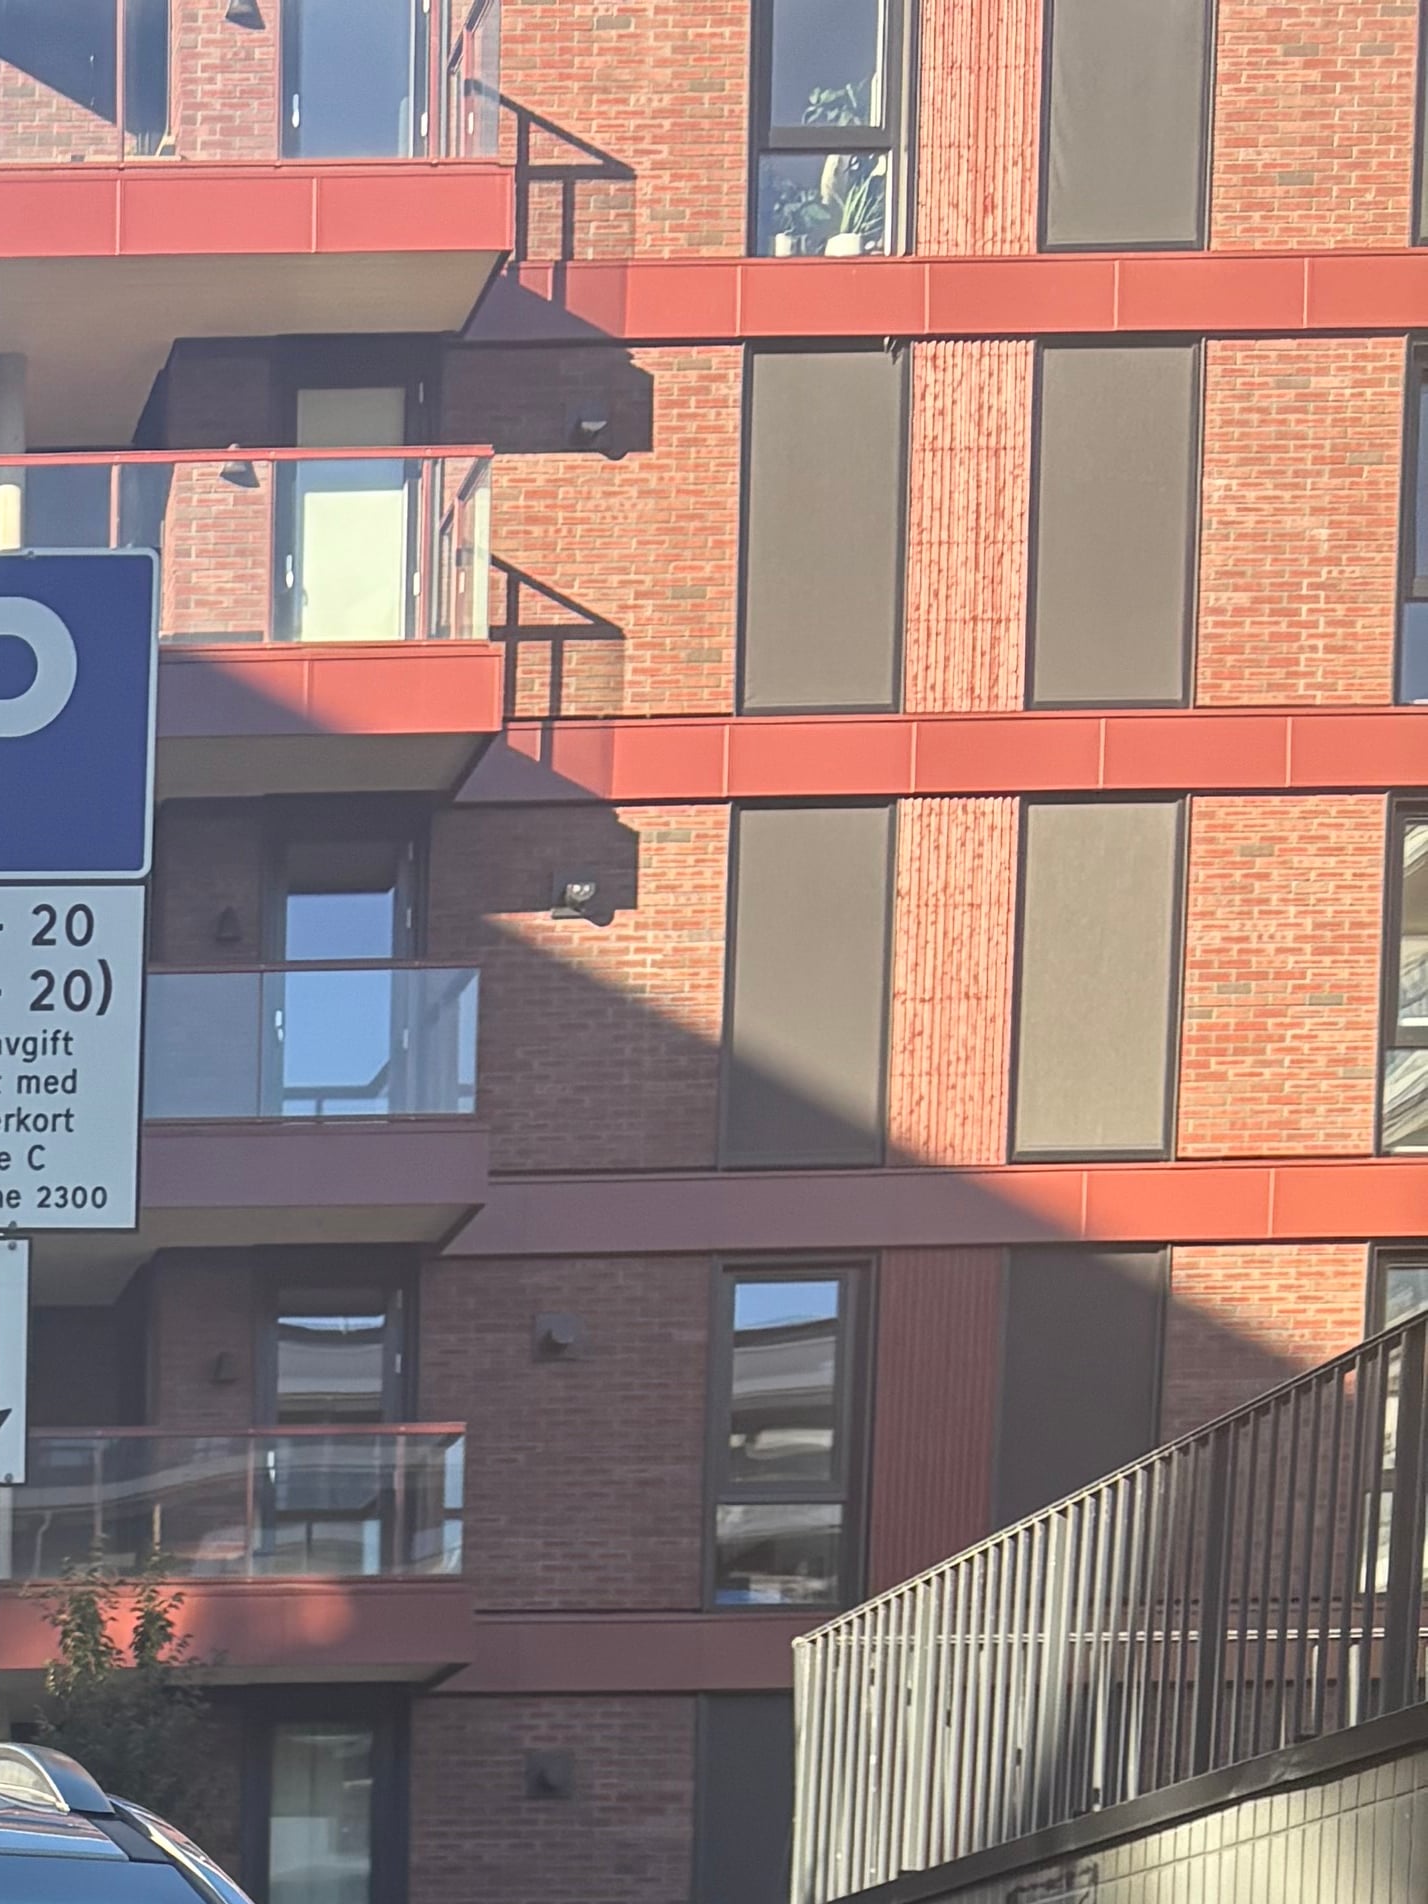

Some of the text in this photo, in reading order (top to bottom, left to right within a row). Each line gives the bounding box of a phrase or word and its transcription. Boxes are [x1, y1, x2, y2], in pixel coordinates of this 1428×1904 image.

[30, 903, 95, 947] 20
[28, 958, 114, 1017] 20)
[16, 1068, 78, 1095] med
[27, 1144, 47, 1171] C
[36, 1185, 108, 1209] 2300
